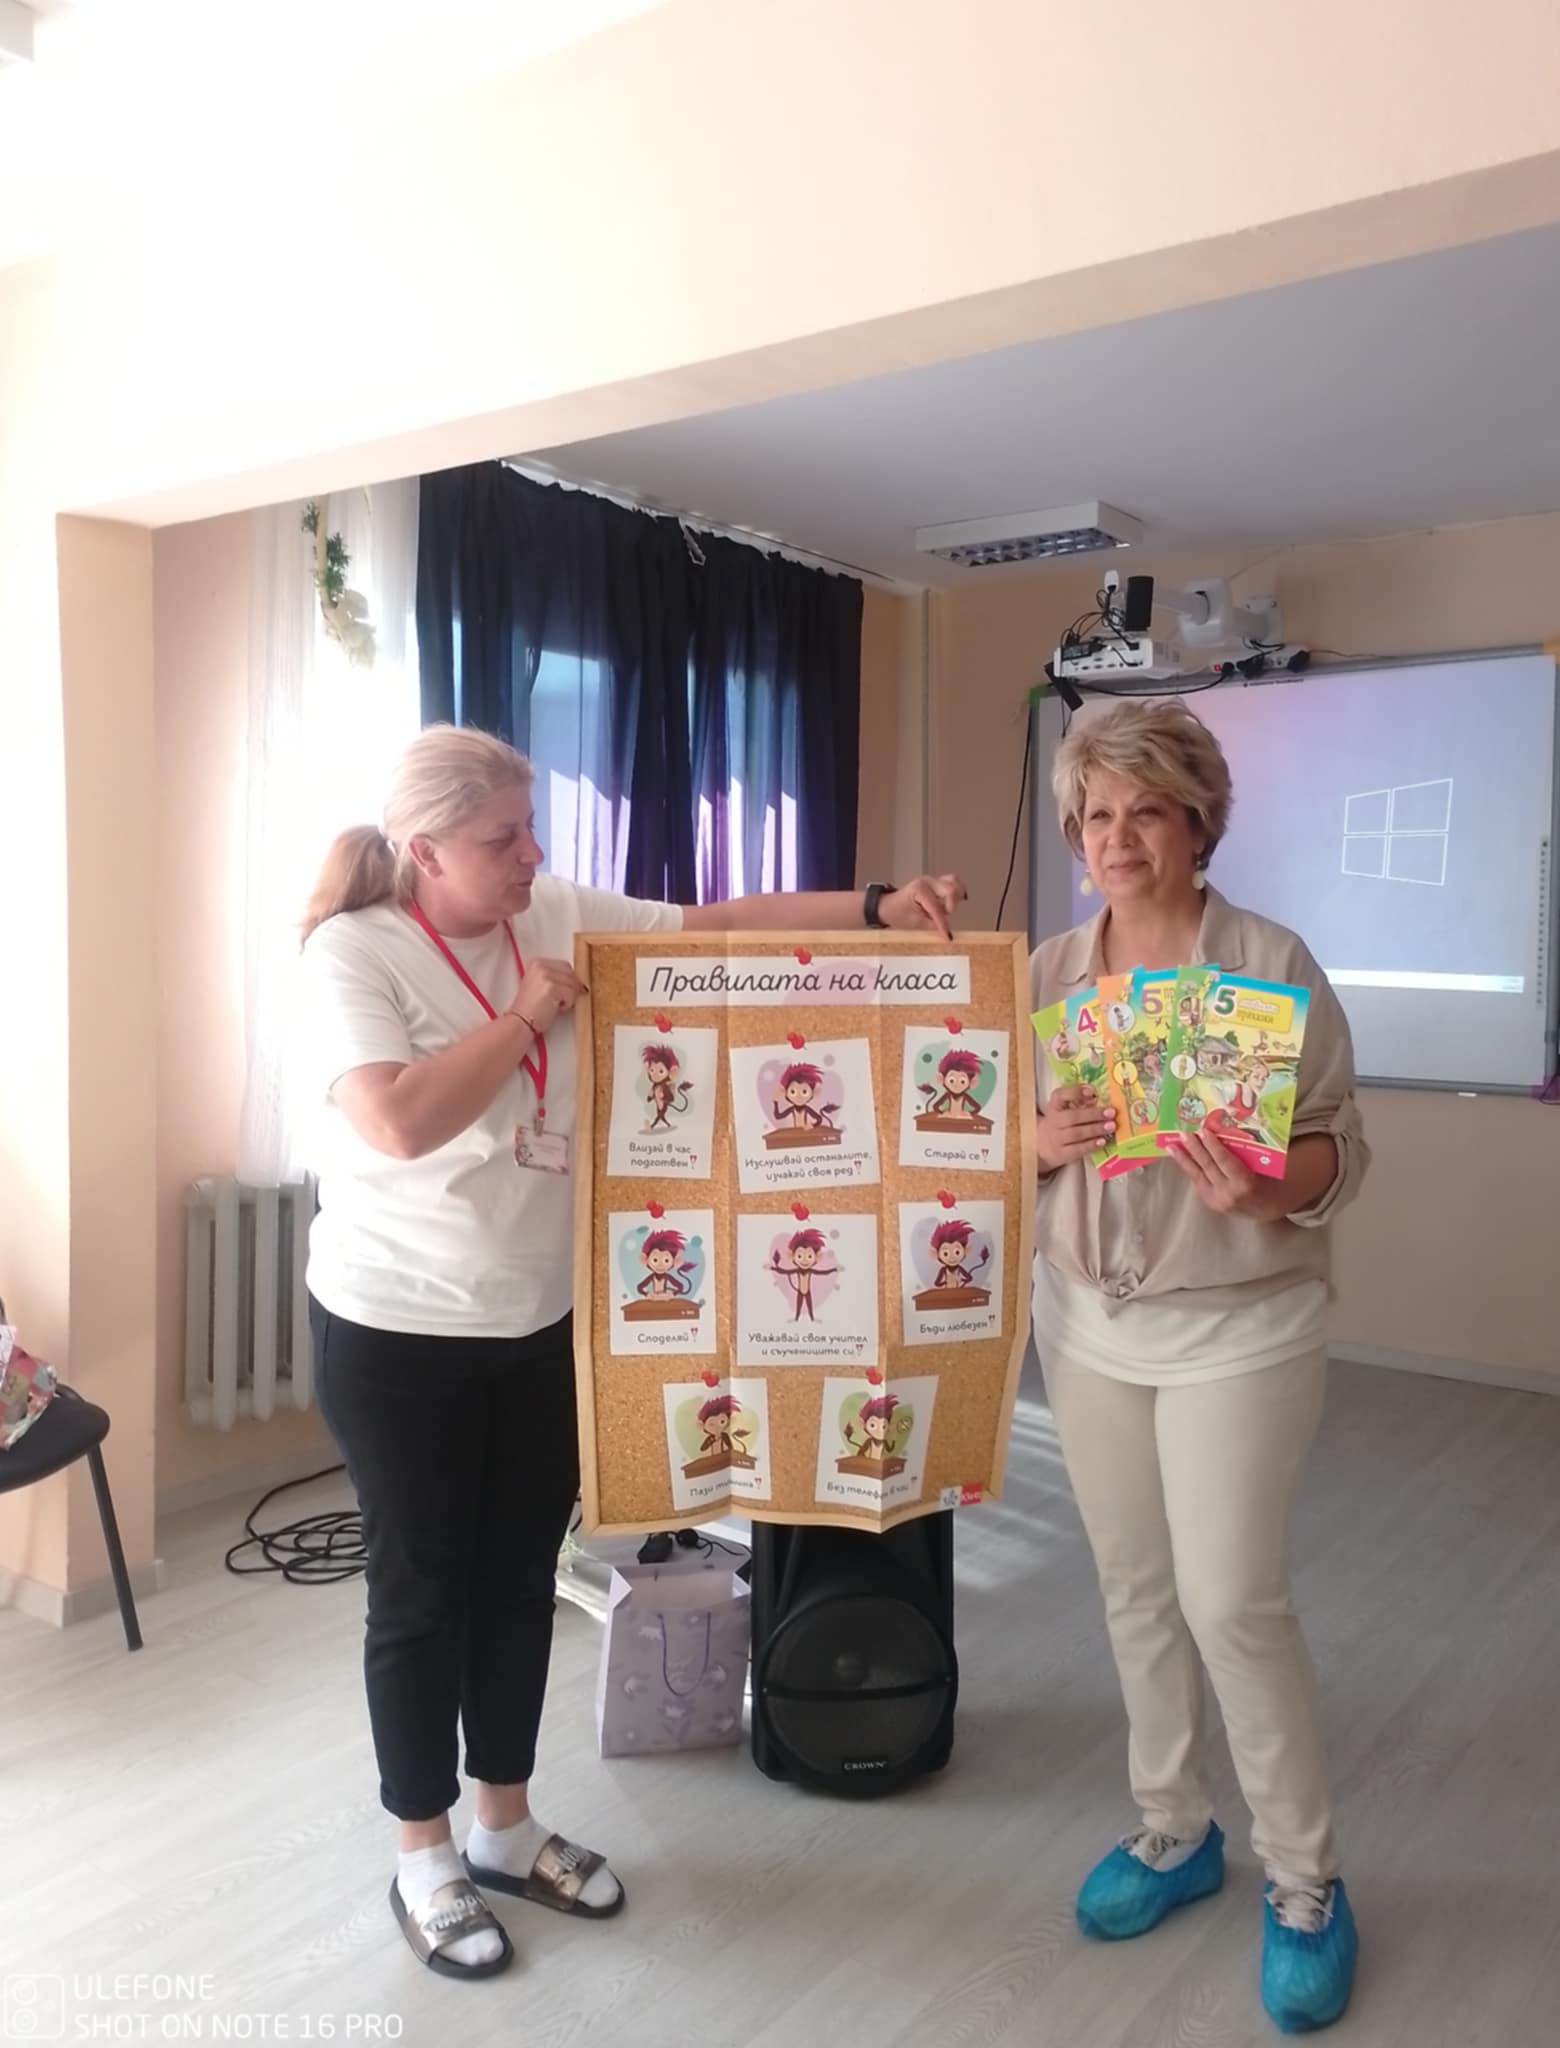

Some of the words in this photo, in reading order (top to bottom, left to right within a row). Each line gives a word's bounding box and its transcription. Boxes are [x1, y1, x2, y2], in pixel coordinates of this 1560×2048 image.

[650, 965, 821, 1001] Правилата
[829, 973, 866, 992] на
[874, 964, 957, 992] класа
[1142, 988, 1163, 1015] 5
[1214, 987, 1236, 1015] 5
[1077, 1008, 1098, 1033] 4
[924, 1148, 967, 1161] Старай
